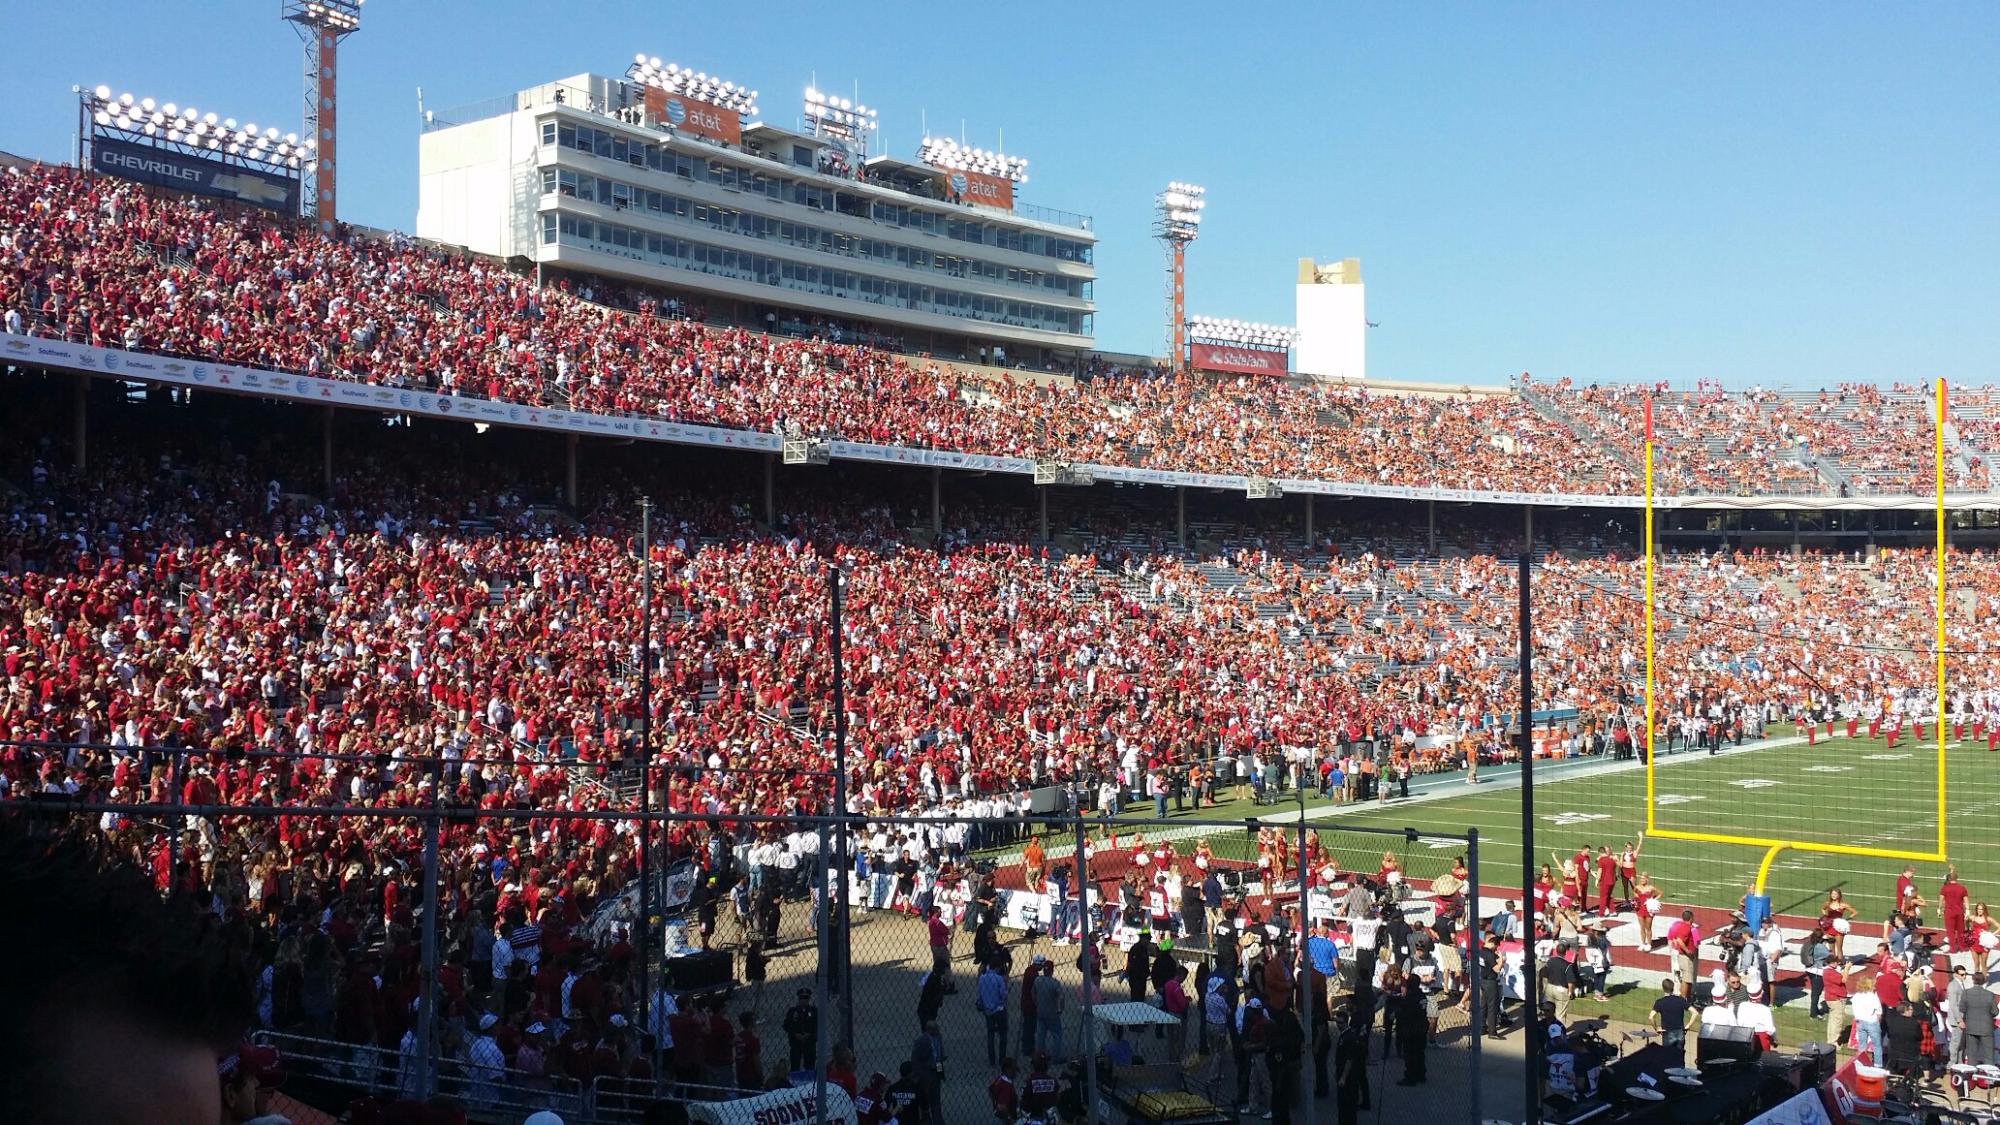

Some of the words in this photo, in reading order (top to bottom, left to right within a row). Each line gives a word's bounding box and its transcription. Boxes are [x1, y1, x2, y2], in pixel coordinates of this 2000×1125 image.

[689, 109, 721, 132] at&t
[101, 151, 203, 183] CHEVROLET
[971, 180, 998, 199] at&t
[38, 347, 68, 359] Southwest
[754, 1097, 820, 1125] SOONE
